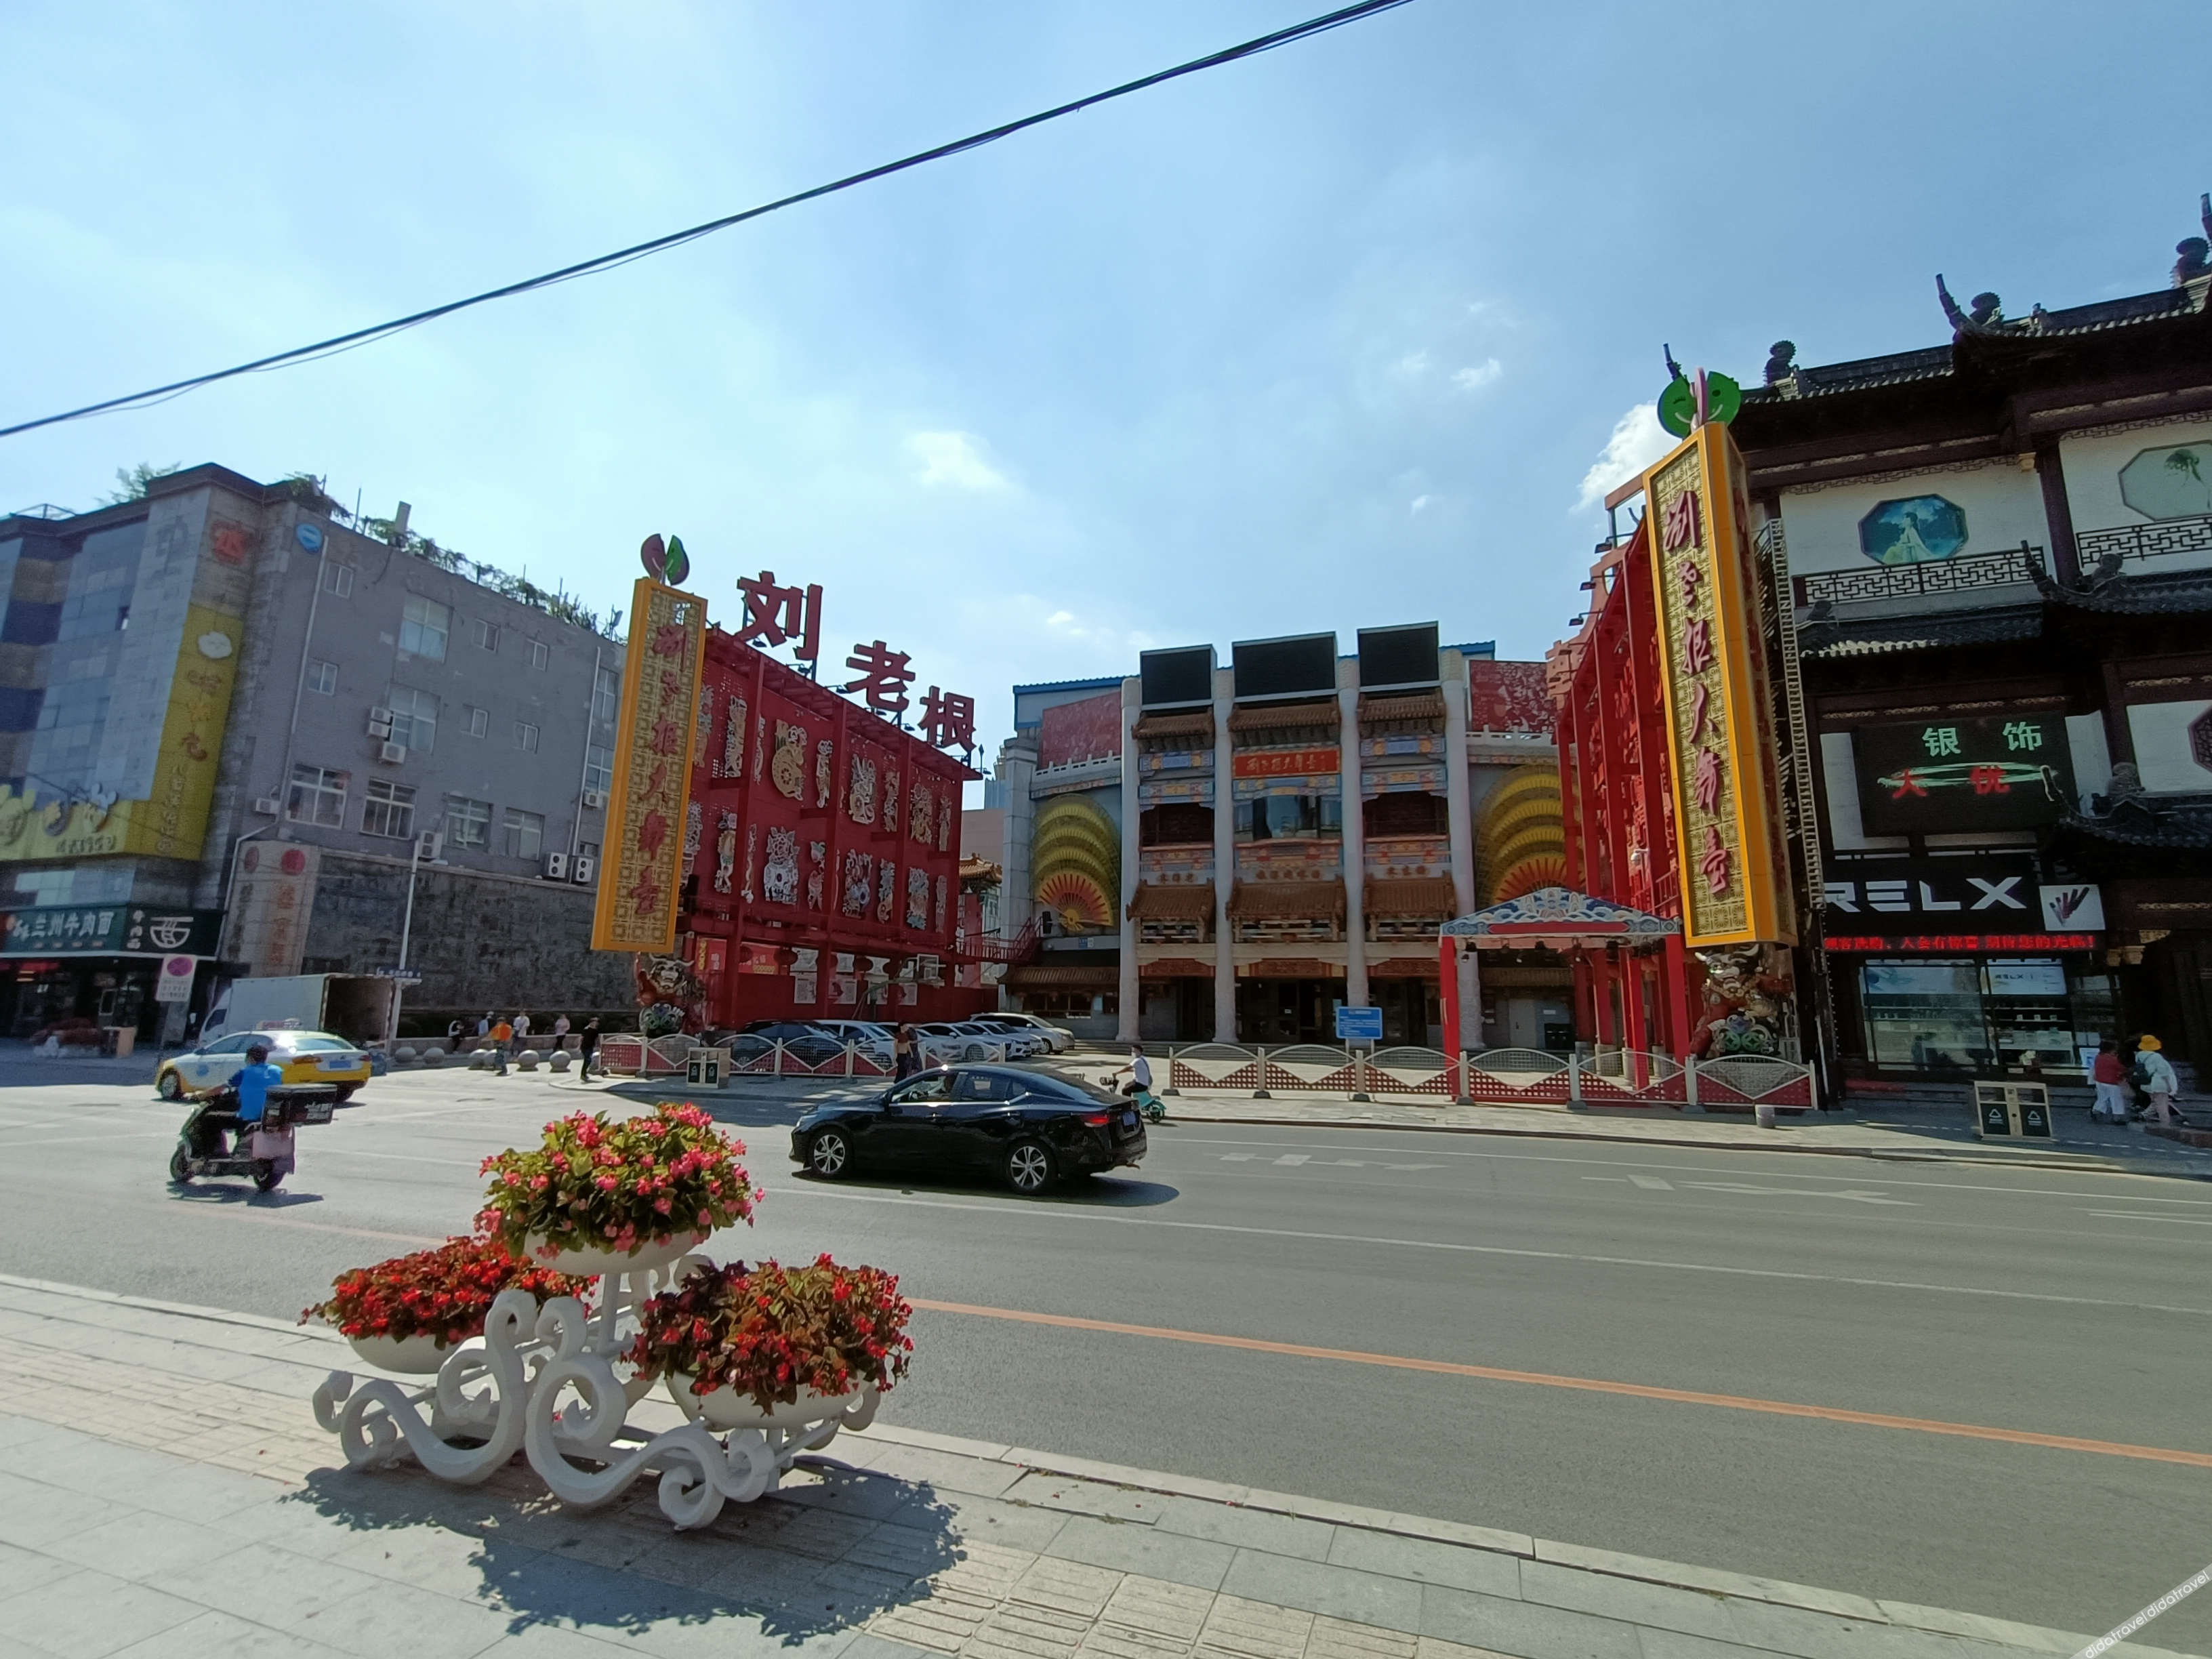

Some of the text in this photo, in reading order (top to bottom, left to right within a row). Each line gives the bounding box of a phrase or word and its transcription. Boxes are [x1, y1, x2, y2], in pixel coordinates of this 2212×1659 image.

[735, 570, 977, 752] 刘老根
[1921, 721, 2043, 757] 银饰
[1824, 876, 2027, 913] RELX
